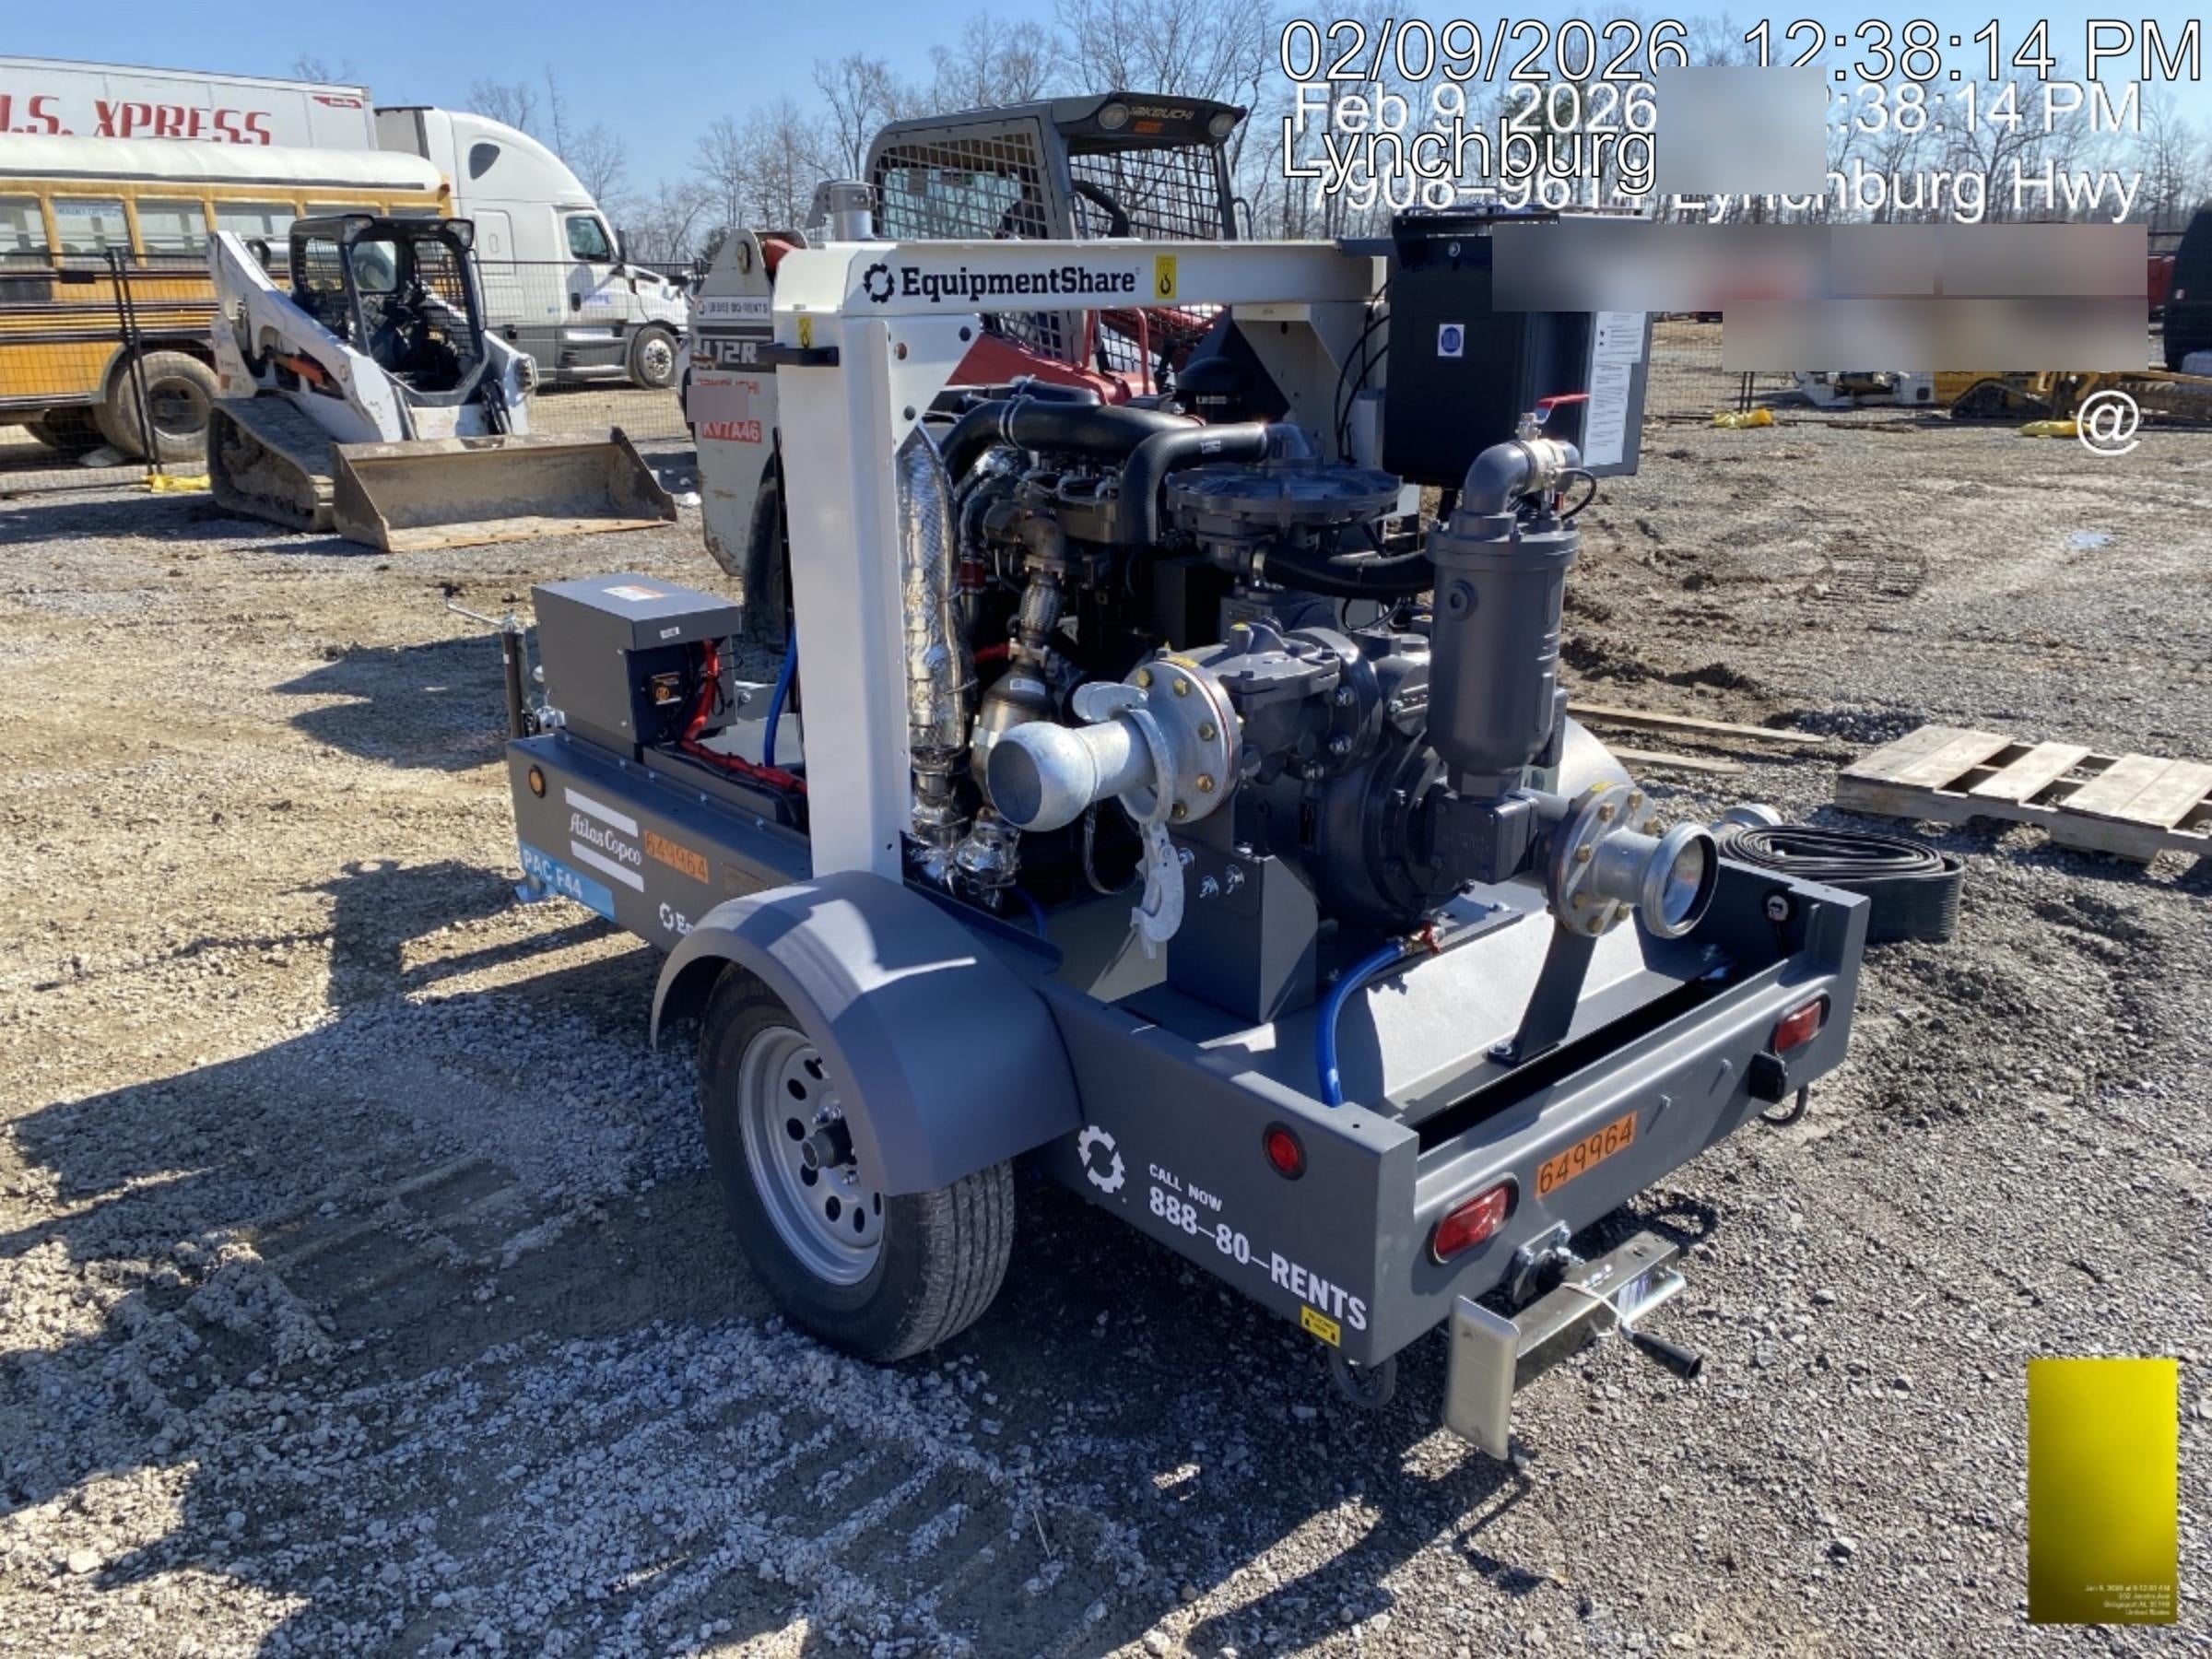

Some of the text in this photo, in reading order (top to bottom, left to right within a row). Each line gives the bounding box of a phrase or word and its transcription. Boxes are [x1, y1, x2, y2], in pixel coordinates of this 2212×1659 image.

[94, 100, 271, 146] XPRESS
[900, 266, 1137, 302] EquipmentShare
[570, 813, 642, 866] Atlas Copco
[523, 849, 583, 900] PAC F44
[1540, 1115, 1632, 1194] 649964
[1149, 1163, 1223, 1212] CALL NOW
[1149, 1186, 1368, 1331] 888-80-RENTS
